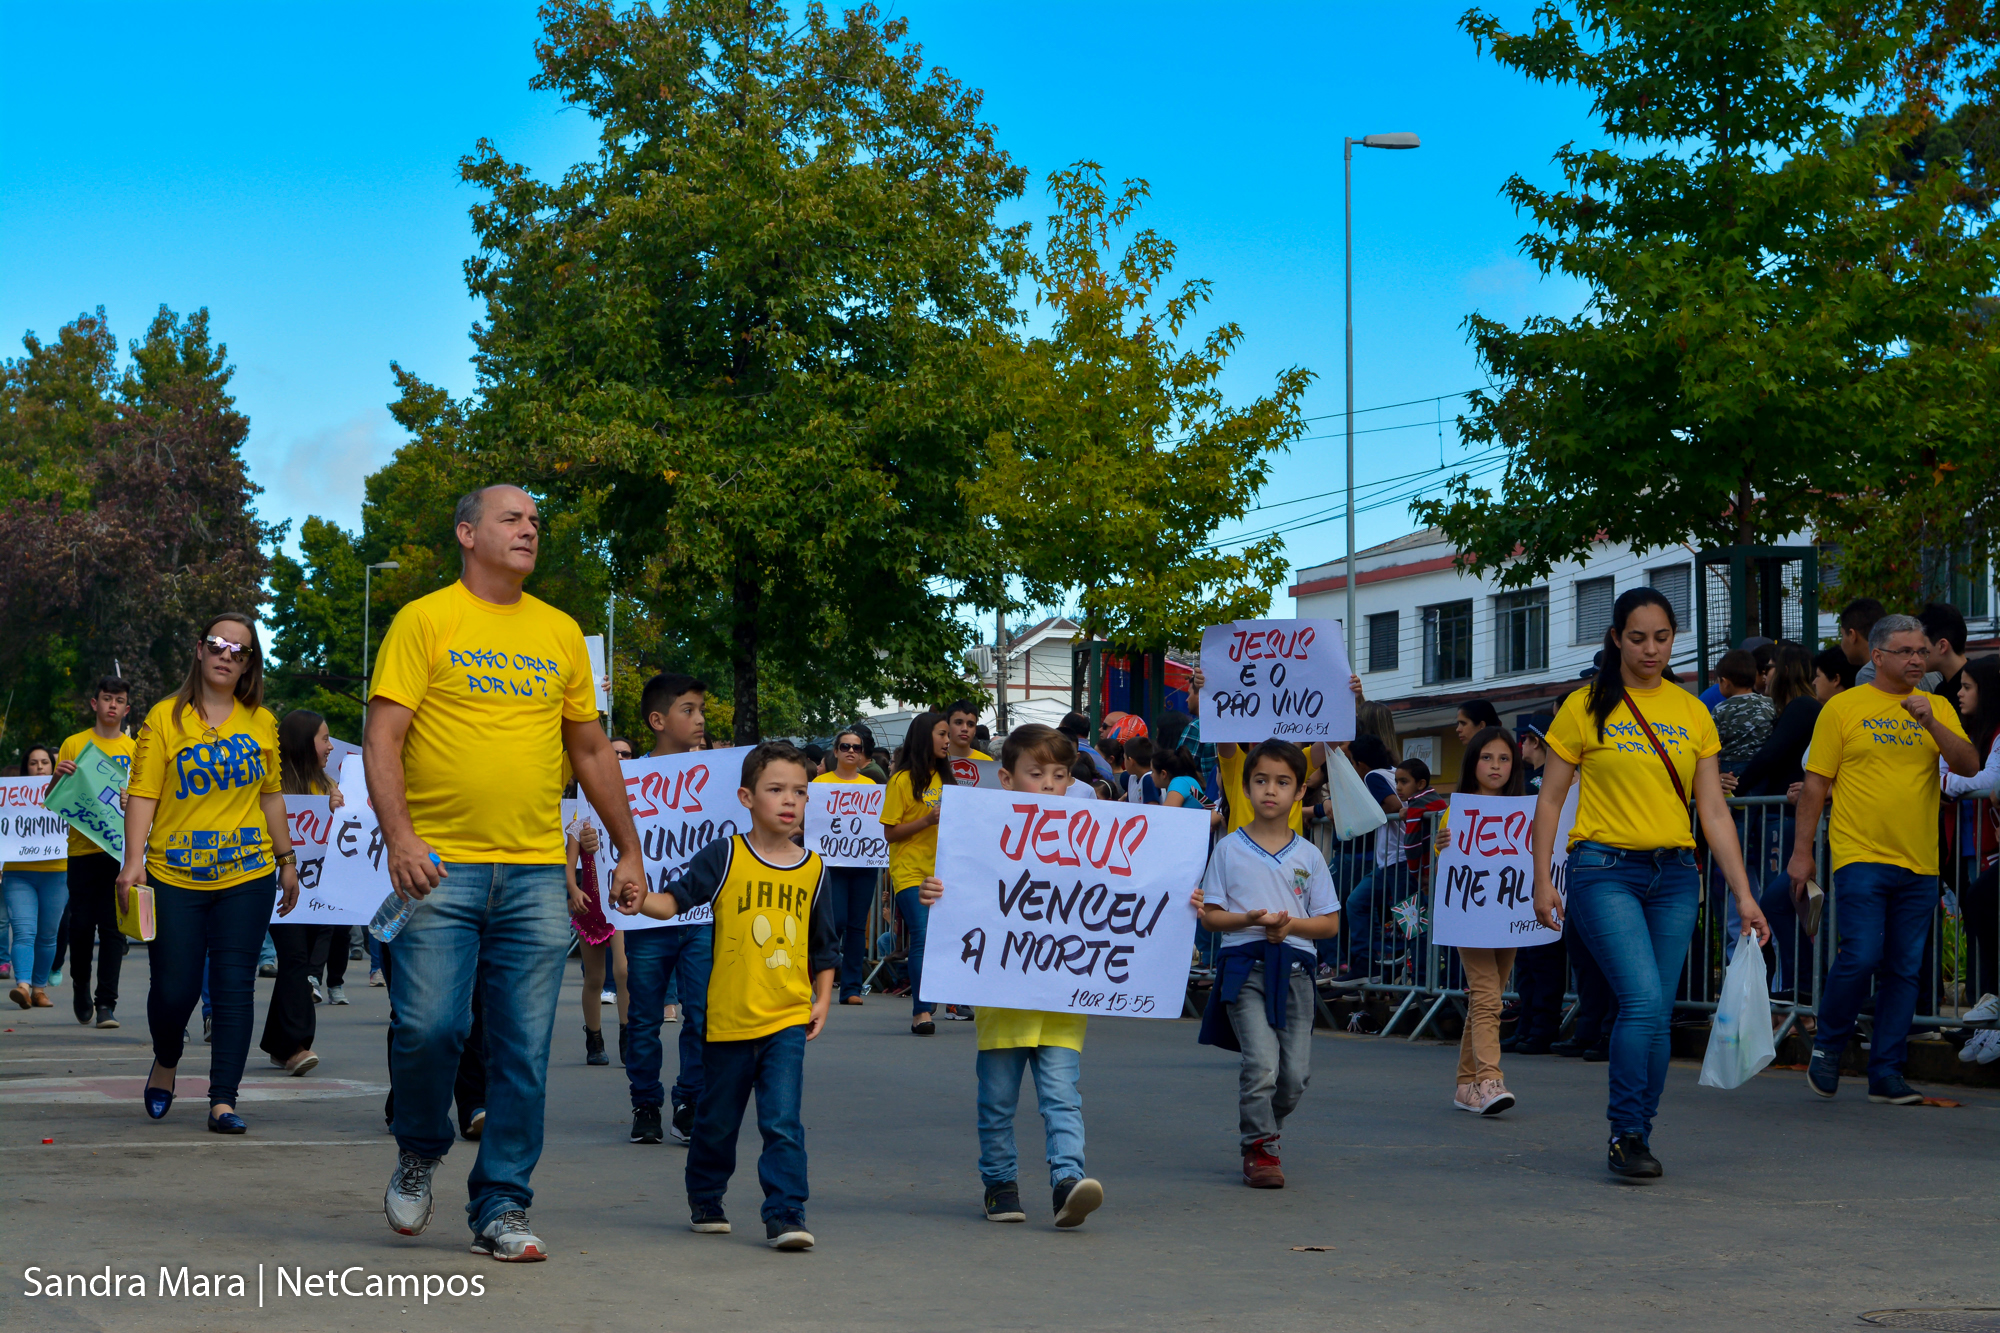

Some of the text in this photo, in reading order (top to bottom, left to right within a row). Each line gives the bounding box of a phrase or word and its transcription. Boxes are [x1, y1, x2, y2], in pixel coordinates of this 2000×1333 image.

[1228, 626, 1316, 663] JESUS
[448, 647, 560, 677] POSSO ORAR
[1269, 662, 1287, 688] O
[466, 673, 508, 696] POR
[1272, 687, 1324, 719] VIVO
[1872, 732, 1898, 746] POR
[1901, 719, 1926, 732] ORA
[177, 733, 261, 769] PODER
[1614, 740, 1648, 754] POR
[175, 756, 265, 800] JOVEM
[625, 764, 710, 819] ESUS
[826, 789, 882, 816] JESUS
[15, 814, 70, 838] CAMINH
[850, 816, 862, 836] O
[999, 803, 1149, 877] JESUS
[1458, 809, 1554, 857] JES
[737, 880, 808, 924] JAKE
[998, 868, 1170, 939] VENCEU
[1444, 864, 1491, 913] ME
[960, 927, 1135, 984] A MORTE
[1105, 991, 1155, 1013] 15:55
